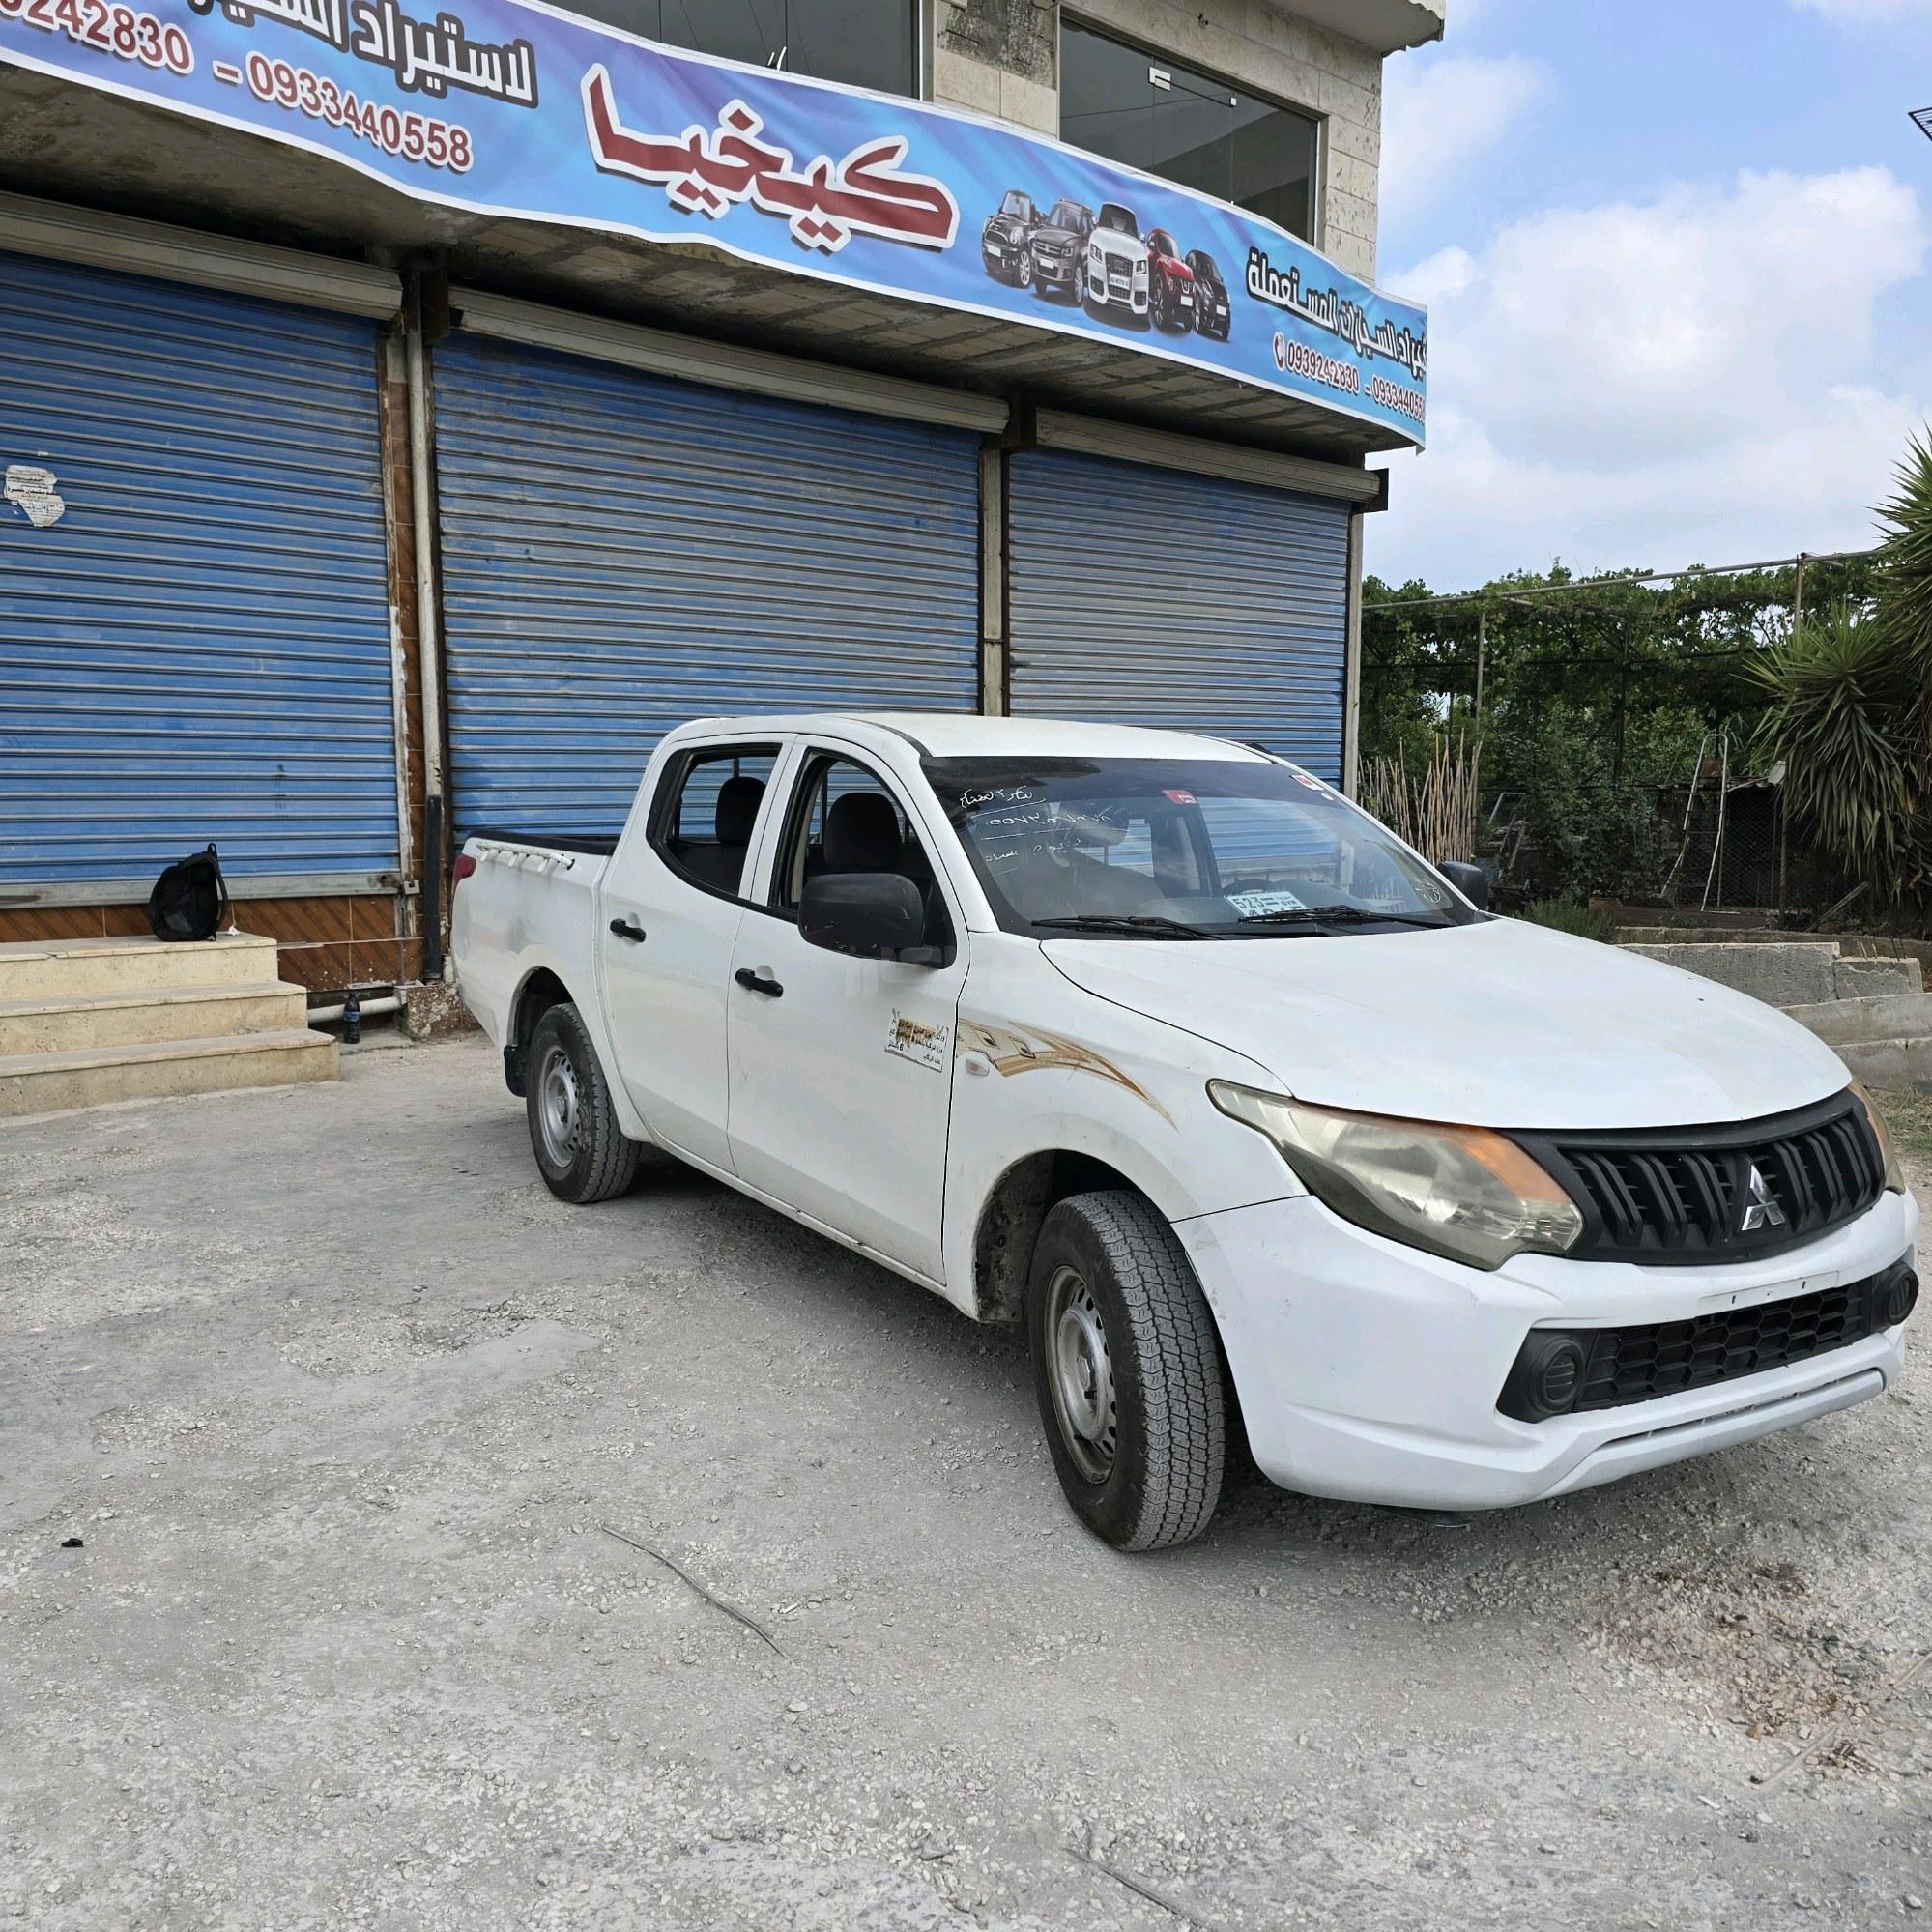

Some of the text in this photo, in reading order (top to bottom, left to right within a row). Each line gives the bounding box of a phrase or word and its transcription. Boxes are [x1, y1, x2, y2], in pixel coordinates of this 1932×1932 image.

[0, 0, 192, 71] 242830
[248, 53, 472, 168] 0933440558
[356, 0, 534, 104] لاستيراد
[586, 70, 957, 245] كيخيا
[1247, 250, 1339, 333] المستعملة
[1339, 302, 1398, 359] السيارات
[1287, 343, 1360, 392] 0939242830
